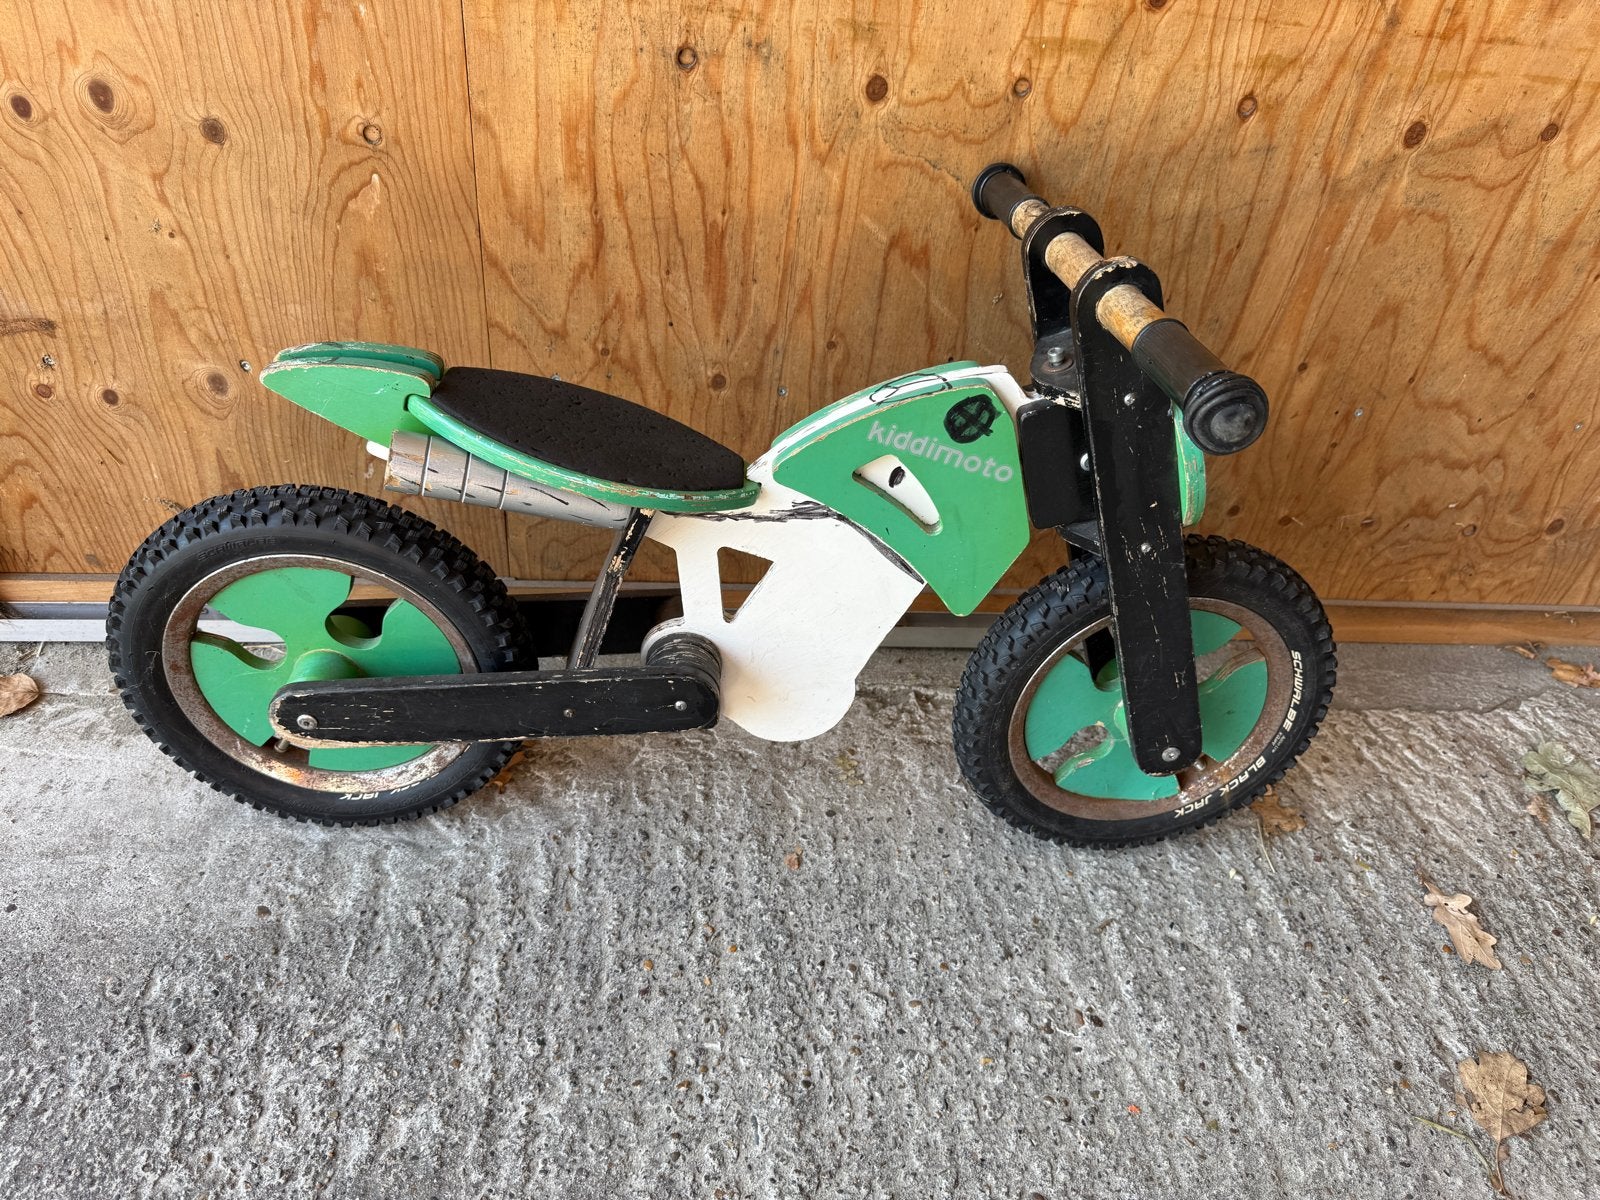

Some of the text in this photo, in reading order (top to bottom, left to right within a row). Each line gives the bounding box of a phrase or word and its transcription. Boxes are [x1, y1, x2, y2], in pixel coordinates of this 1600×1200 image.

[867, 420, 1013, 483] kiddimoto
[1282, 650, 1304, 732] SCHWALBE
[1174, 755, 1267, 819] BLACK JACK
